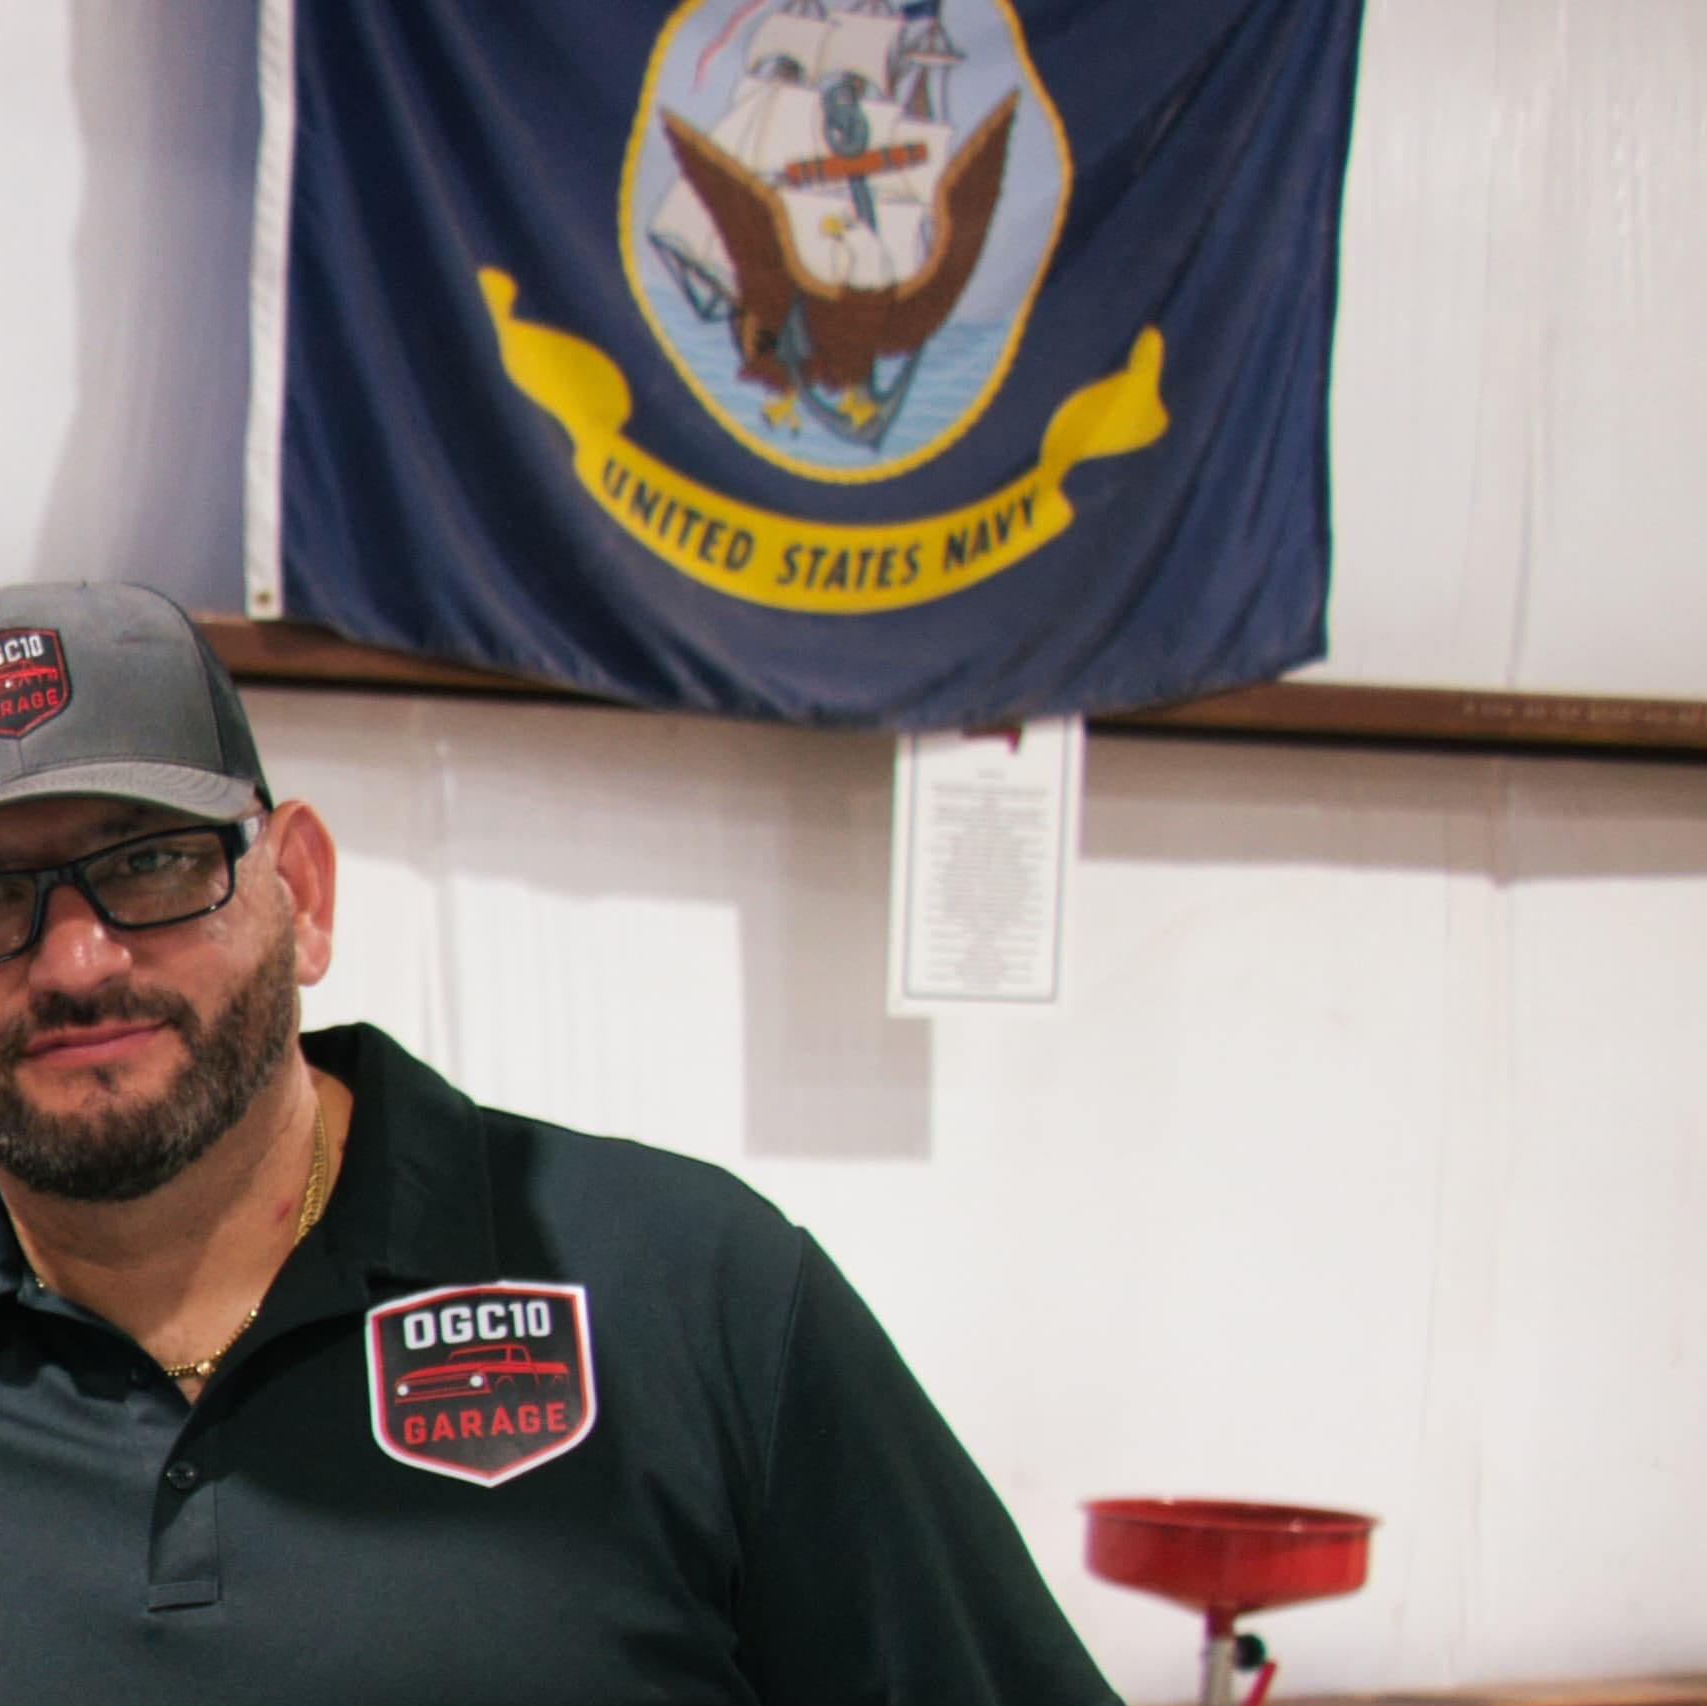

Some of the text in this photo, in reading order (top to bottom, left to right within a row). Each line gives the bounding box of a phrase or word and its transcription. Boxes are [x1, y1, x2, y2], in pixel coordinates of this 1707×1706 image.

[601, 456, 1045, 593] UNITED STATES NAVY
[403, 1300, 552, 1350] OGC10
[404, 1403, 568, 1445] GARAGE
